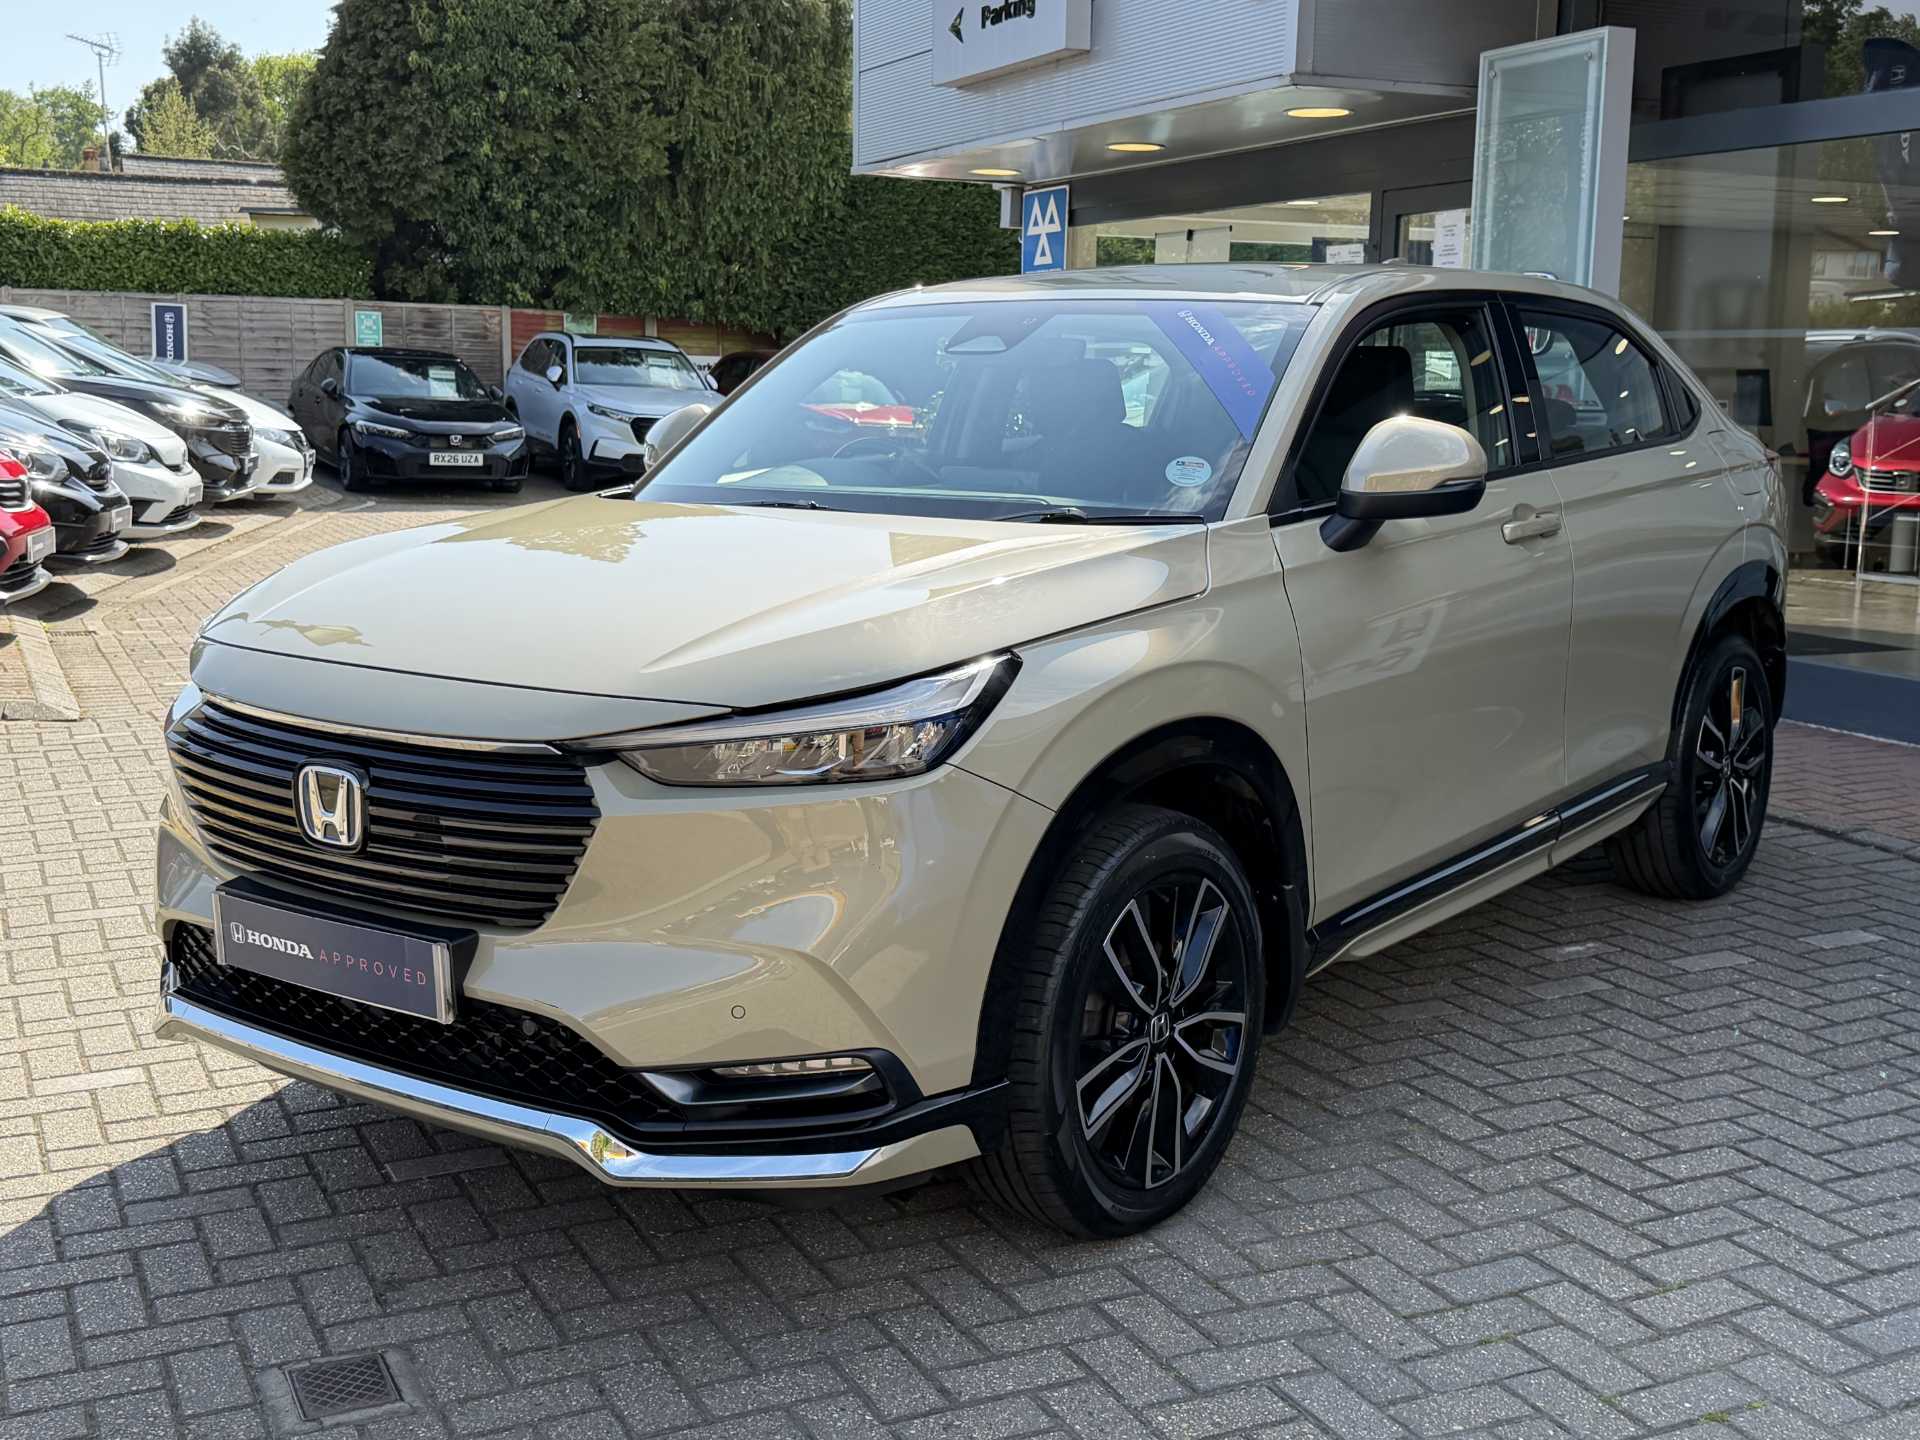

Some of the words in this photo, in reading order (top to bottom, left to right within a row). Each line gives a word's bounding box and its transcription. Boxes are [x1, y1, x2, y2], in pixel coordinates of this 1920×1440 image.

[981, 0, 1036, 29] Parking
[165, 323, 174, 360] HOND
[1184, 315, 1216, 346] HONDA
[433, 454, 460, 464] RX26
[461, 455, 480, 464] UZA
[247, 929, 315, 961] HONDA
[318, 949, 427, 986] APPROVED
